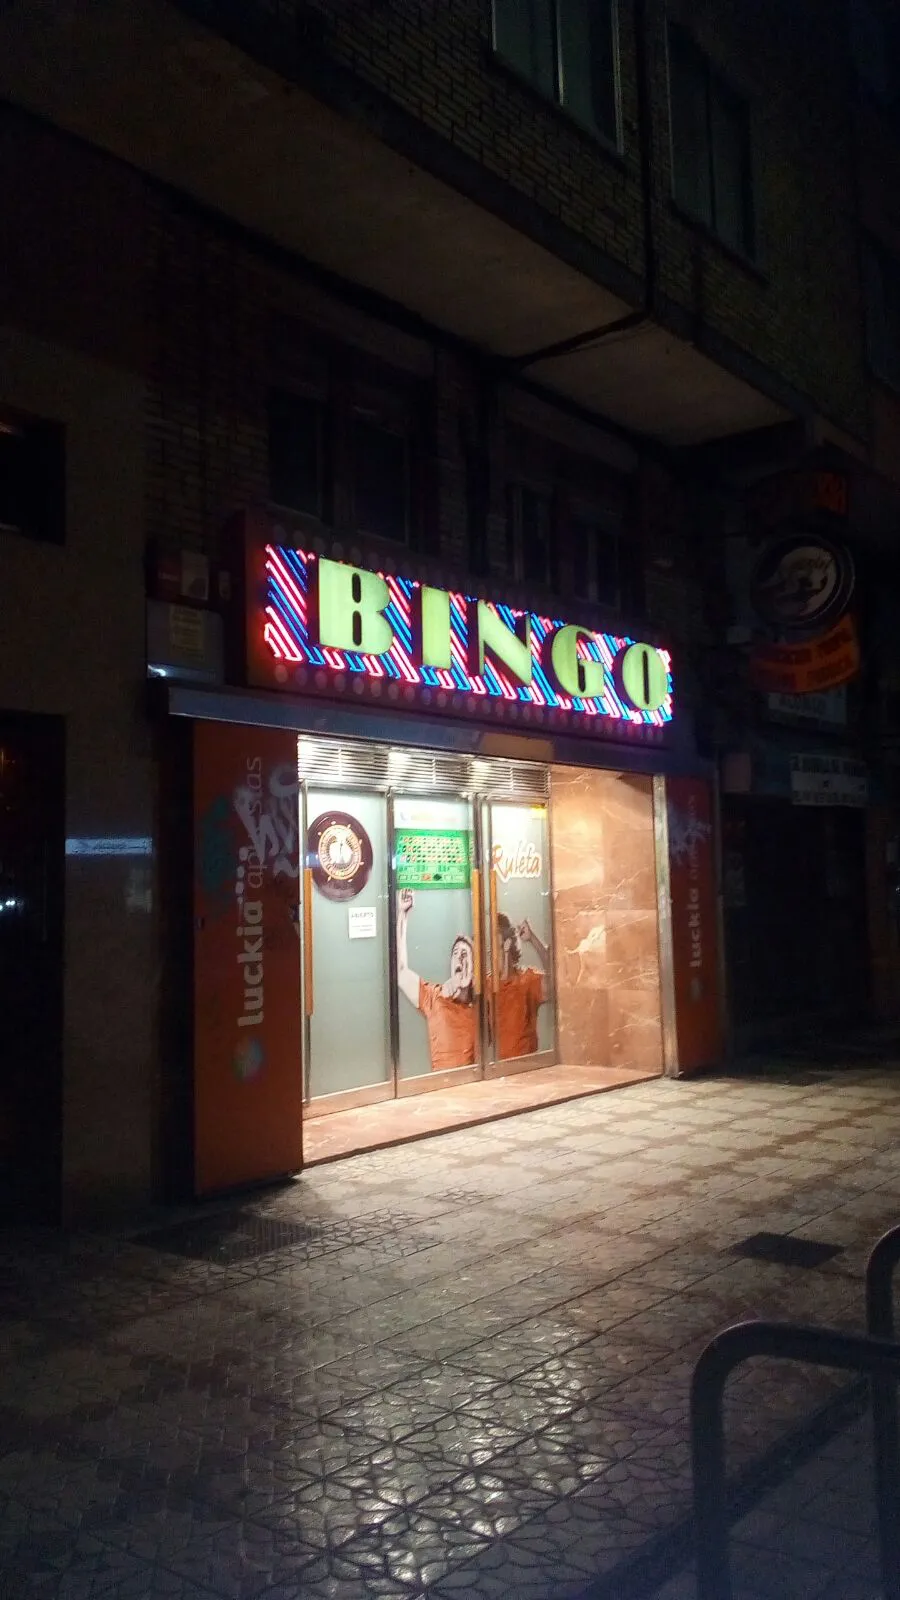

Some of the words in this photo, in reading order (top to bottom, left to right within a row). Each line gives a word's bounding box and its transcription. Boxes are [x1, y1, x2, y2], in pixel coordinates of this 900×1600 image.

[318, 557, 669, 711] BINGO
[491, 838, 542, 878] Ruleta
[236, 900, 264, 1027] luckia
